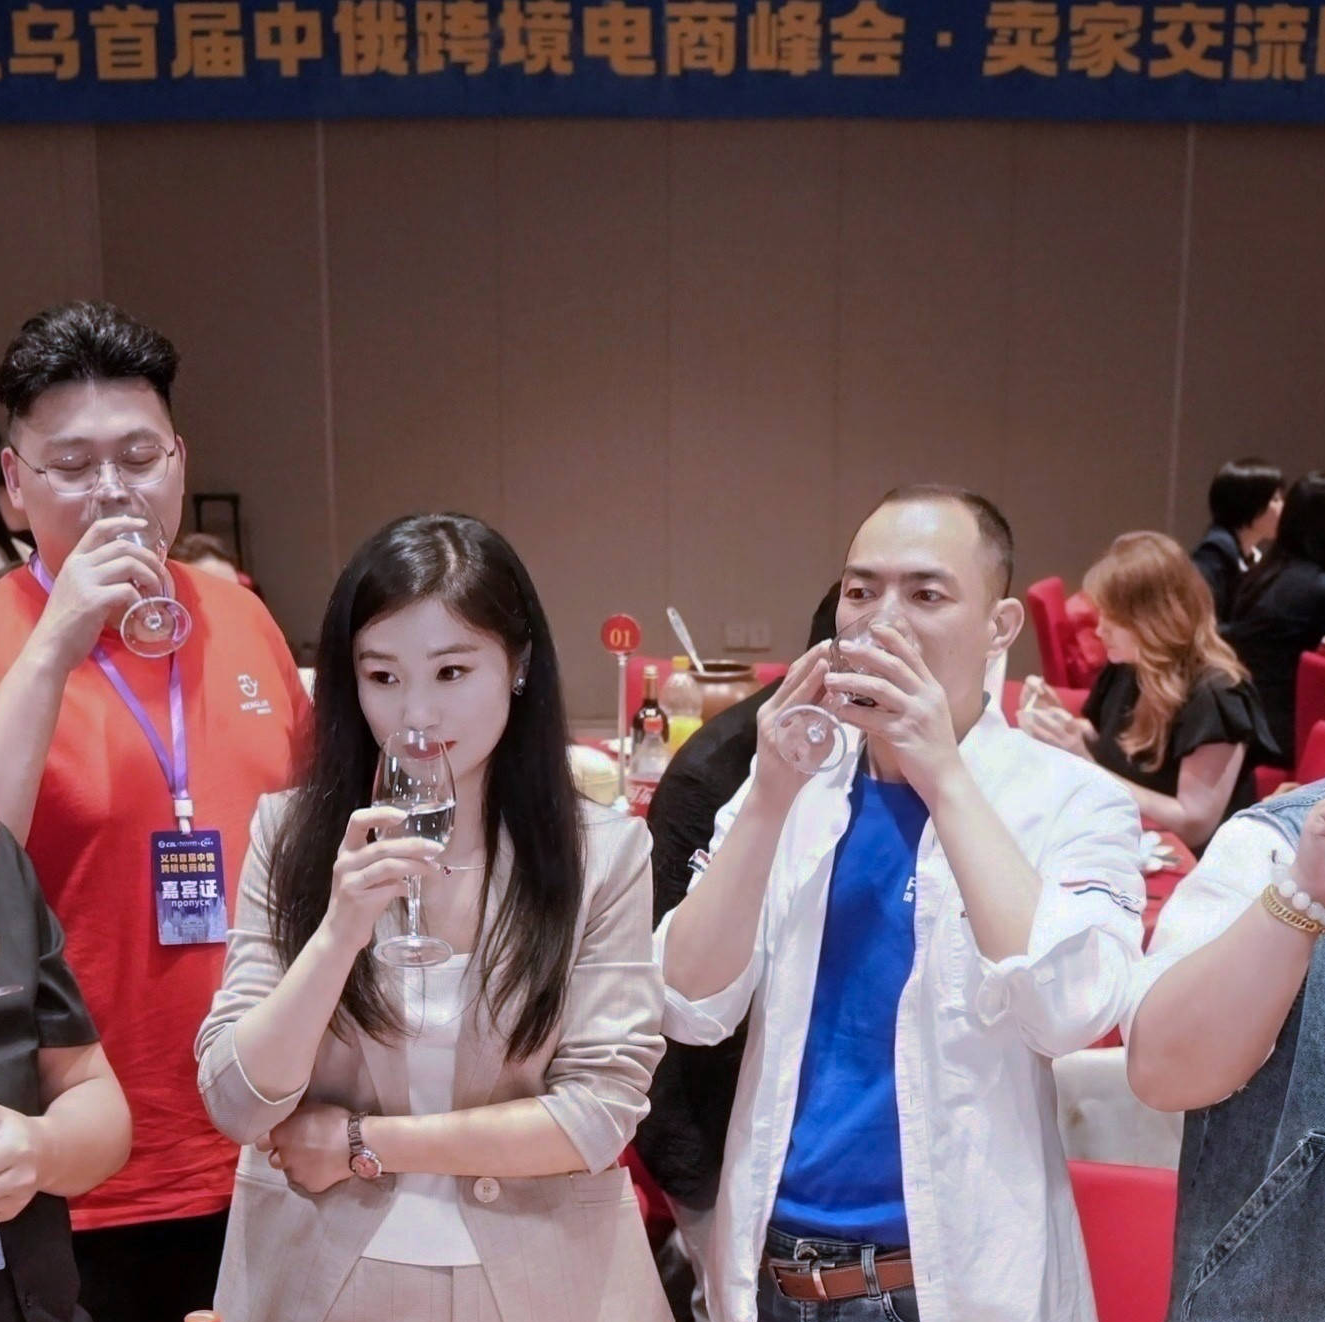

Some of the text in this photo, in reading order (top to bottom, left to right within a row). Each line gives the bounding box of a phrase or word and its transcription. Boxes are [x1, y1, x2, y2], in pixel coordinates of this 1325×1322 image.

[609, 627, 630, 648] 01
[161, 879, 218, 899] 嘉宾证
[171, 900, 211, 909] пропуск
